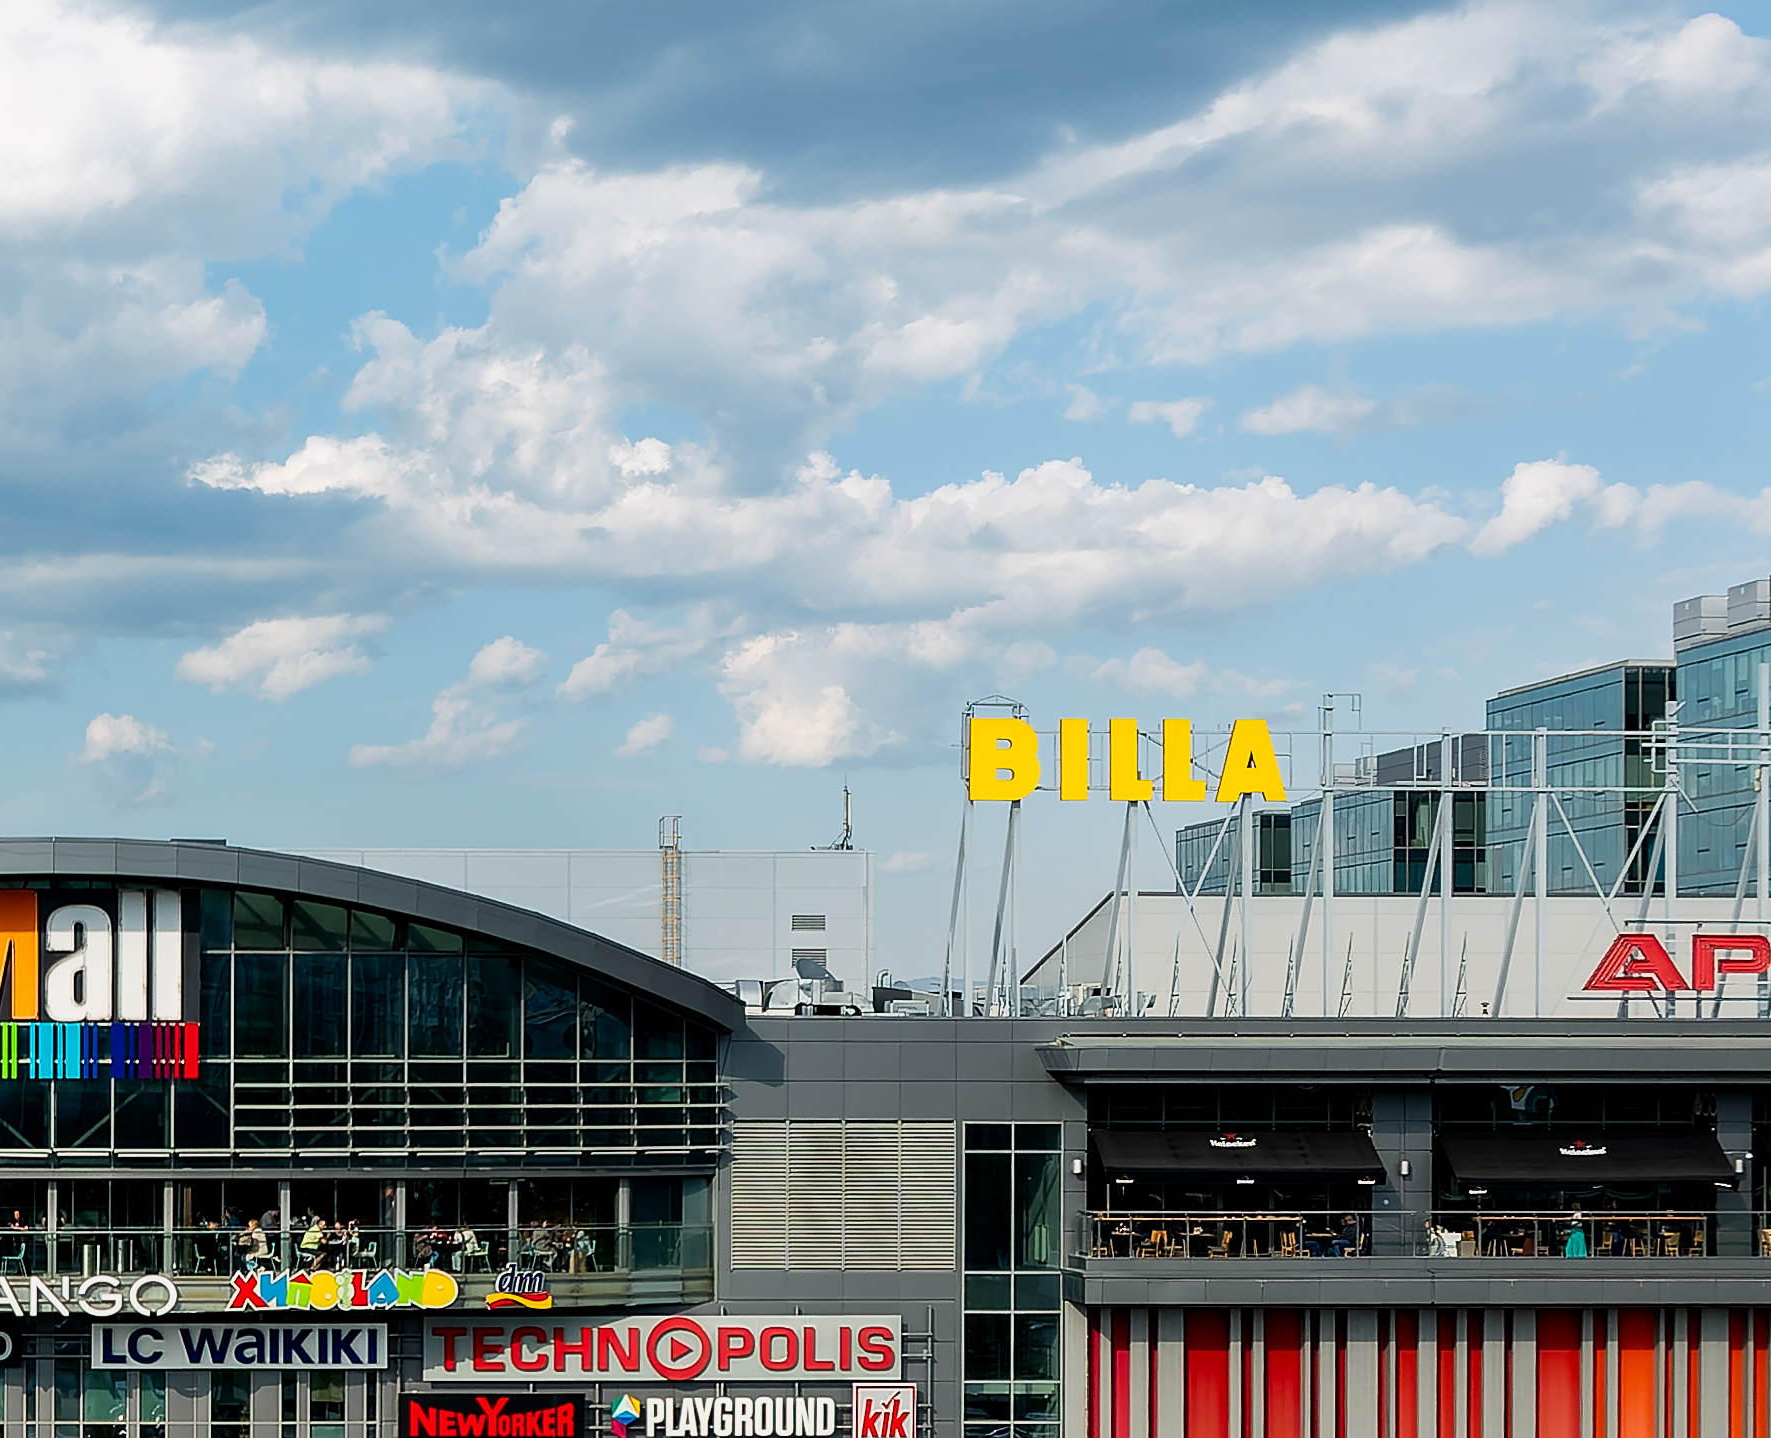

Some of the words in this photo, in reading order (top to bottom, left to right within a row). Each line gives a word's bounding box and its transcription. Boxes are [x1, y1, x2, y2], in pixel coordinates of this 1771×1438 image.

[969, 717, 1287, 803] BILLA
[496, 1262, 545, 1293] dm
[101, 1327, 165, 1365] LC
[646, 1397, 836, 1438] PLAYGROUND
[860, 1388, 908, 1438] kik
